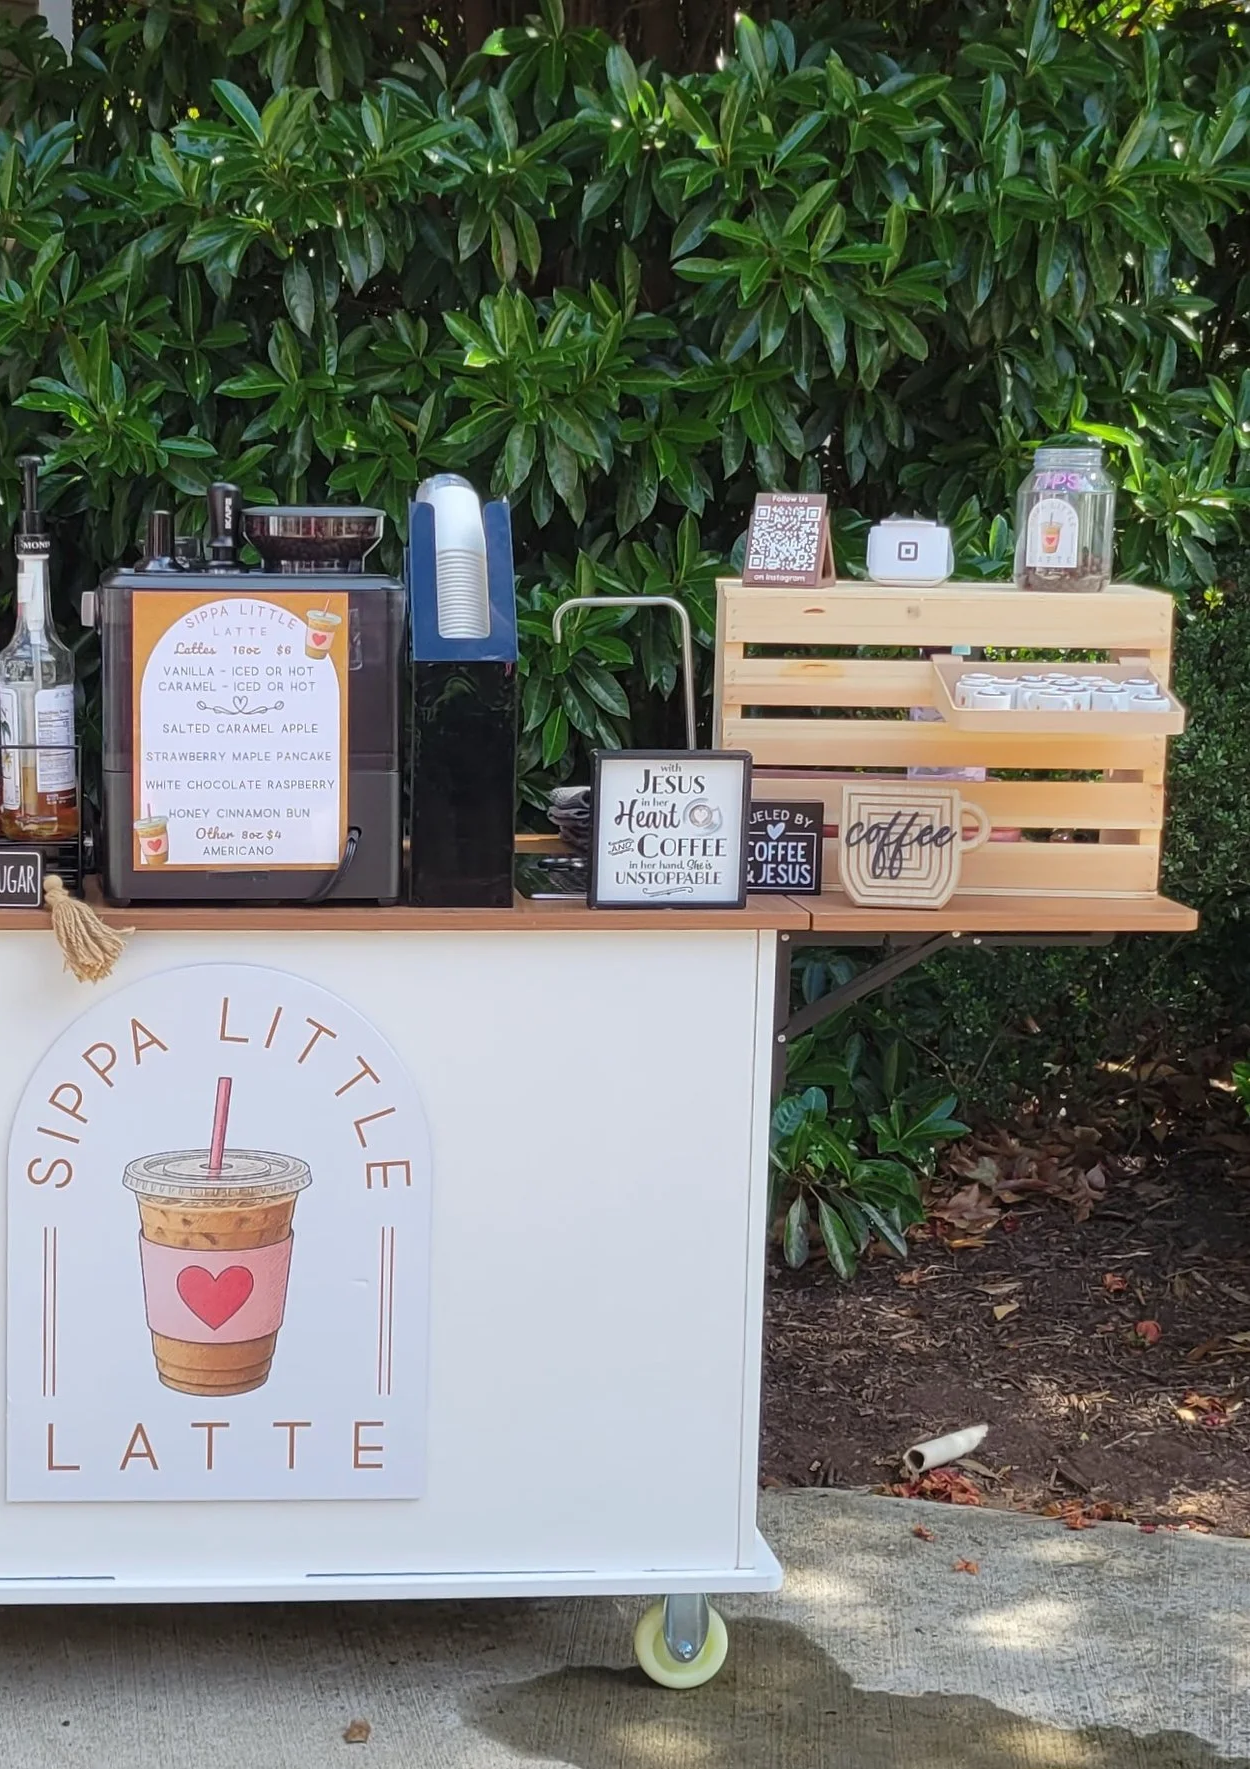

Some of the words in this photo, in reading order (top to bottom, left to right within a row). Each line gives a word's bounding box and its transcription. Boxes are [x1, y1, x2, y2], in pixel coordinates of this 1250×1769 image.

[1033, 472, 1080, 490] TIPS
[772, 495, 797, 503] Follow
[799, 495, 808, 503] Us
[185, 605, 229, 629] SIPPA
[239, 603, 299, 630] LITTLE
[213, 626, 267, 636] LATTE
[174, 642, 217, 655] Lattes
[233, 645, 261, 655] 16oz
[276, 644, 292, 656] $6
[163, 666, 215, 676] VANILLA
[232, 666, 259, 676] ICED
[265, 666, 282, 676] OR
[288, 666, 315, 676] HOT
[158, 682, 217, 692] CARAMEL
[234, 682, 261, 692] ICED
[267, 682, 284, 692] OR
[290, 682, 316, 692] HOT
[163, 724, 210, 734] SALTED
[216, 724, 274, 734] CARAMEL
[281, 724, 318, 734] APPLE
[146, 751, 226, 762] STRAWBERRY
[232, 751, 271, 762] MAPLE
[276, 751, 332, 762] PANCAKE
[660, 763, 682, 773] with
[145, 780, 181, 790] WHITE
[187, 780, 262, 790] CHOCOLATE
[267, 780, 335, 790] RASPBERRY
[636, 769, 705, 794] JESUS
[641, 798, 650, 807] in
[652, 797, 669, 807] her
[169, 808, 210, 819] HONEY
[216, 808, 280, 819] CINNAMON
[286, 808, 310, 819] BUN
[614, 799, 681, 833] Heart
[750, 809, 790, 824] UELED
[794, 813, 814, 828] BY
[196, 827, 235, 840] Other
[241, 830, 264, 841] 8oz
[266, 829, 282, 840] $4
[203, 846, 274, 856] AMERICANO
[611, 842, 632, 852] AND
[637, 833, 727, 858] COFFEE
[845, 811, 957, 879] coffee
[629, 861, 638, 870] in
[640, 861, 656, 870] her
[686, 859, 704, 870] She
[705, 860, 713, 870] is
[615, 871, 722, 885] UNSTOPPABLE
[757, 863, 811, 884] JESUS
[27, 1017, 169, 1190] SIPPA
[218, 997, 413, 1190] LITTLE
[47, 1421, 385, 1471] LATTE
